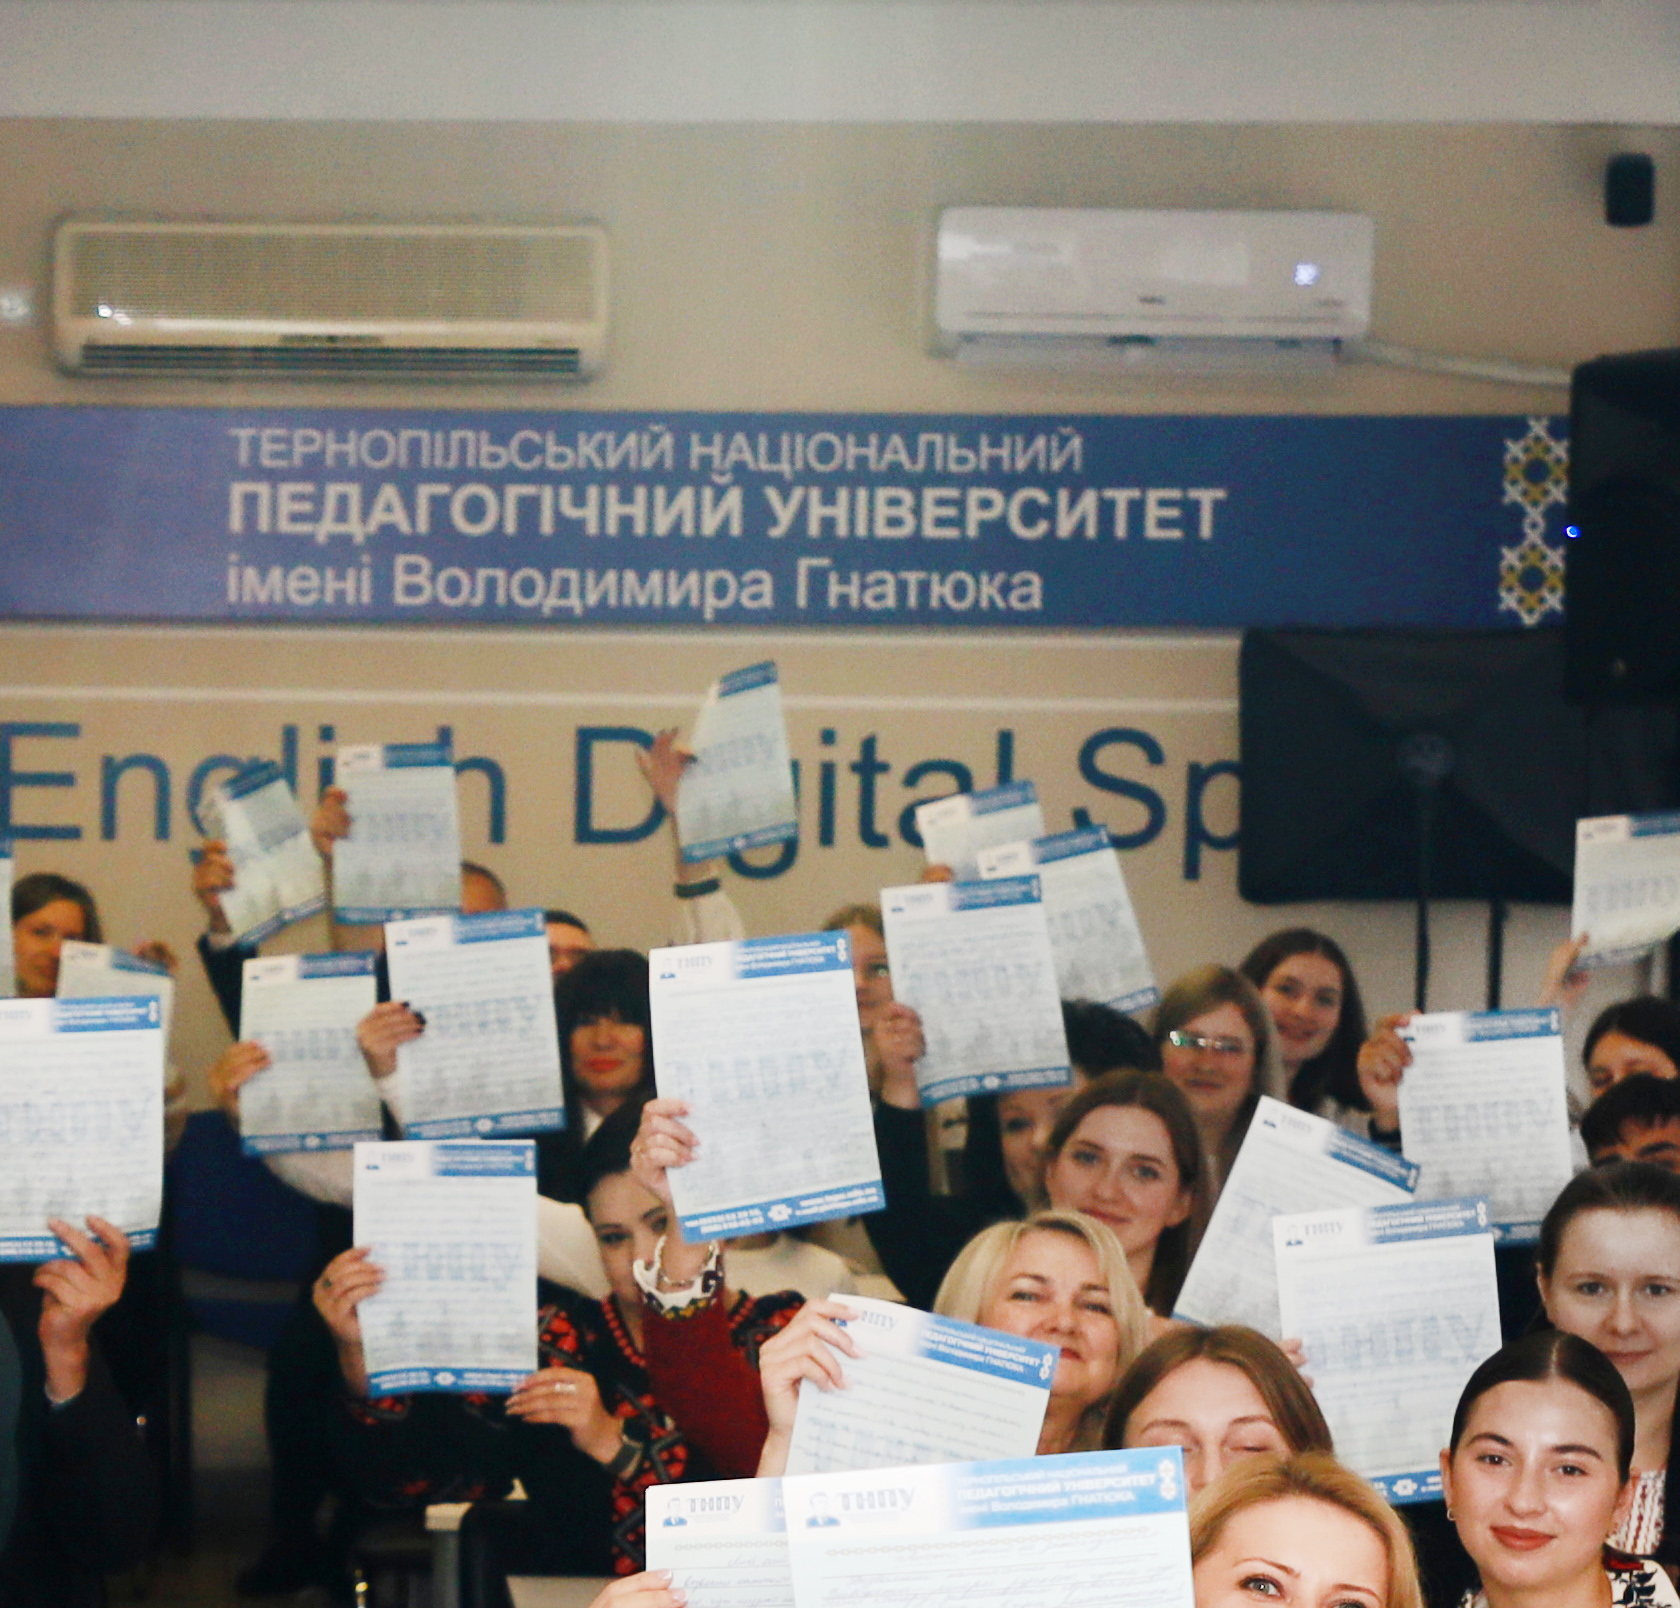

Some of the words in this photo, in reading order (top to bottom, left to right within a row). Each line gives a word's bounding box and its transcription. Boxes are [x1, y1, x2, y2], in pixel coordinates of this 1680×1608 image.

[228, 424, 675, 470] ТЕРНОПІЛЬСЬКИЙ
[689, 426, 1083, 480] НАЦІОНАЛЬНИЙ
[228, 472, 744, 545] ПЕДАГОГІЧНИЙ
[763, 486, 1228, 540] УНІВЕРСИТЕТ
[227, 554, 373, 608] імені
[393, 553, 774, 621] Володимира
[797, 556, 1044, 611] Гнатюка
[690, 1493, 744, 1514] ТНПУ
[843, 1485, 916, 1512] ТНПУ
[958, 1480, 1060, 1501] ПЕДАГОГІЧНИЙ
[1064, 1474, 1155, 1492] УНІВЕРСИТЕТ
